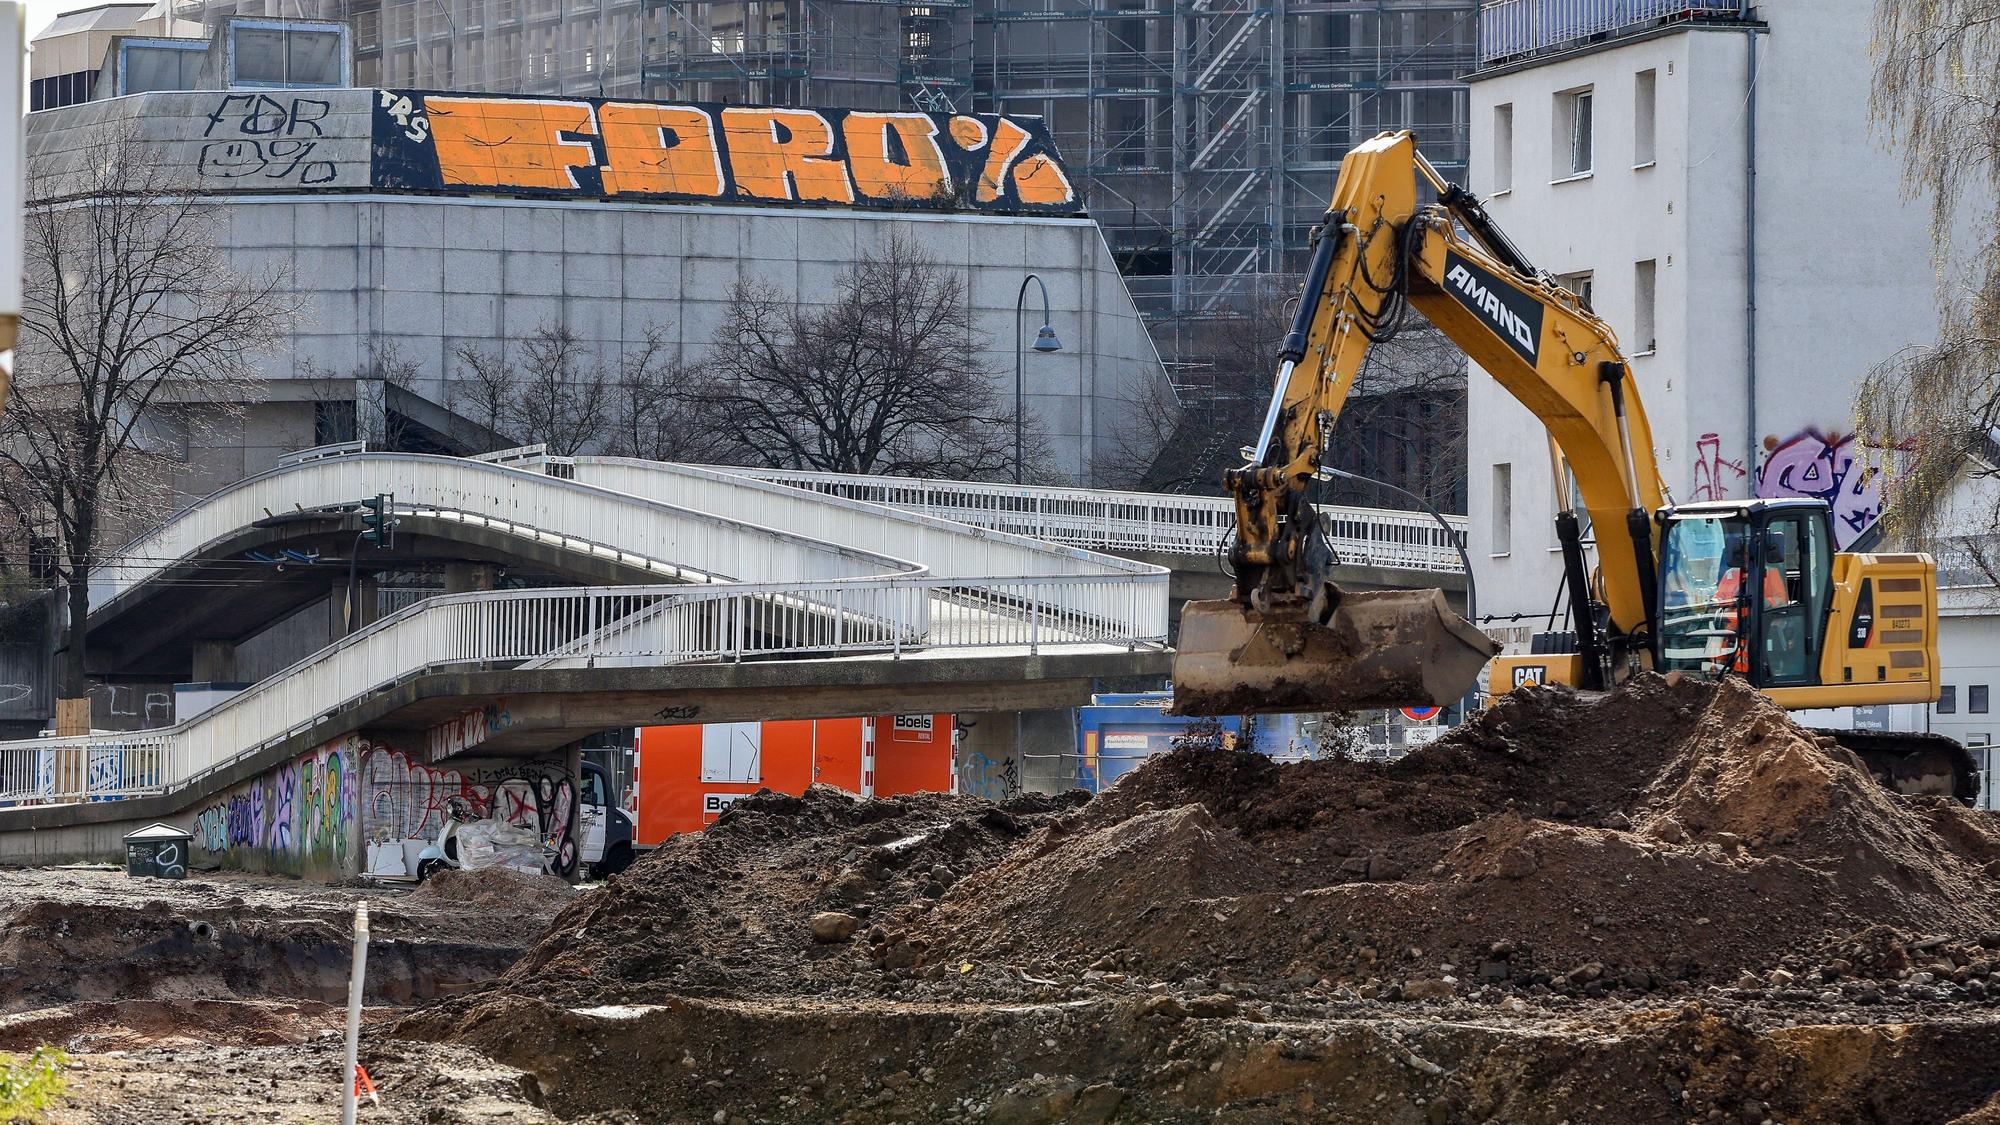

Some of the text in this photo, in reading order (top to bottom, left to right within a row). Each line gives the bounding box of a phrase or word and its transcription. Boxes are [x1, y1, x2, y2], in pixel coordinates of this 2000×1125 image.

[1446, 264, 1535, 356] AMAND
[1514, 668, 1543, 687] CAT
[895, 713, 932, 729] Boels
